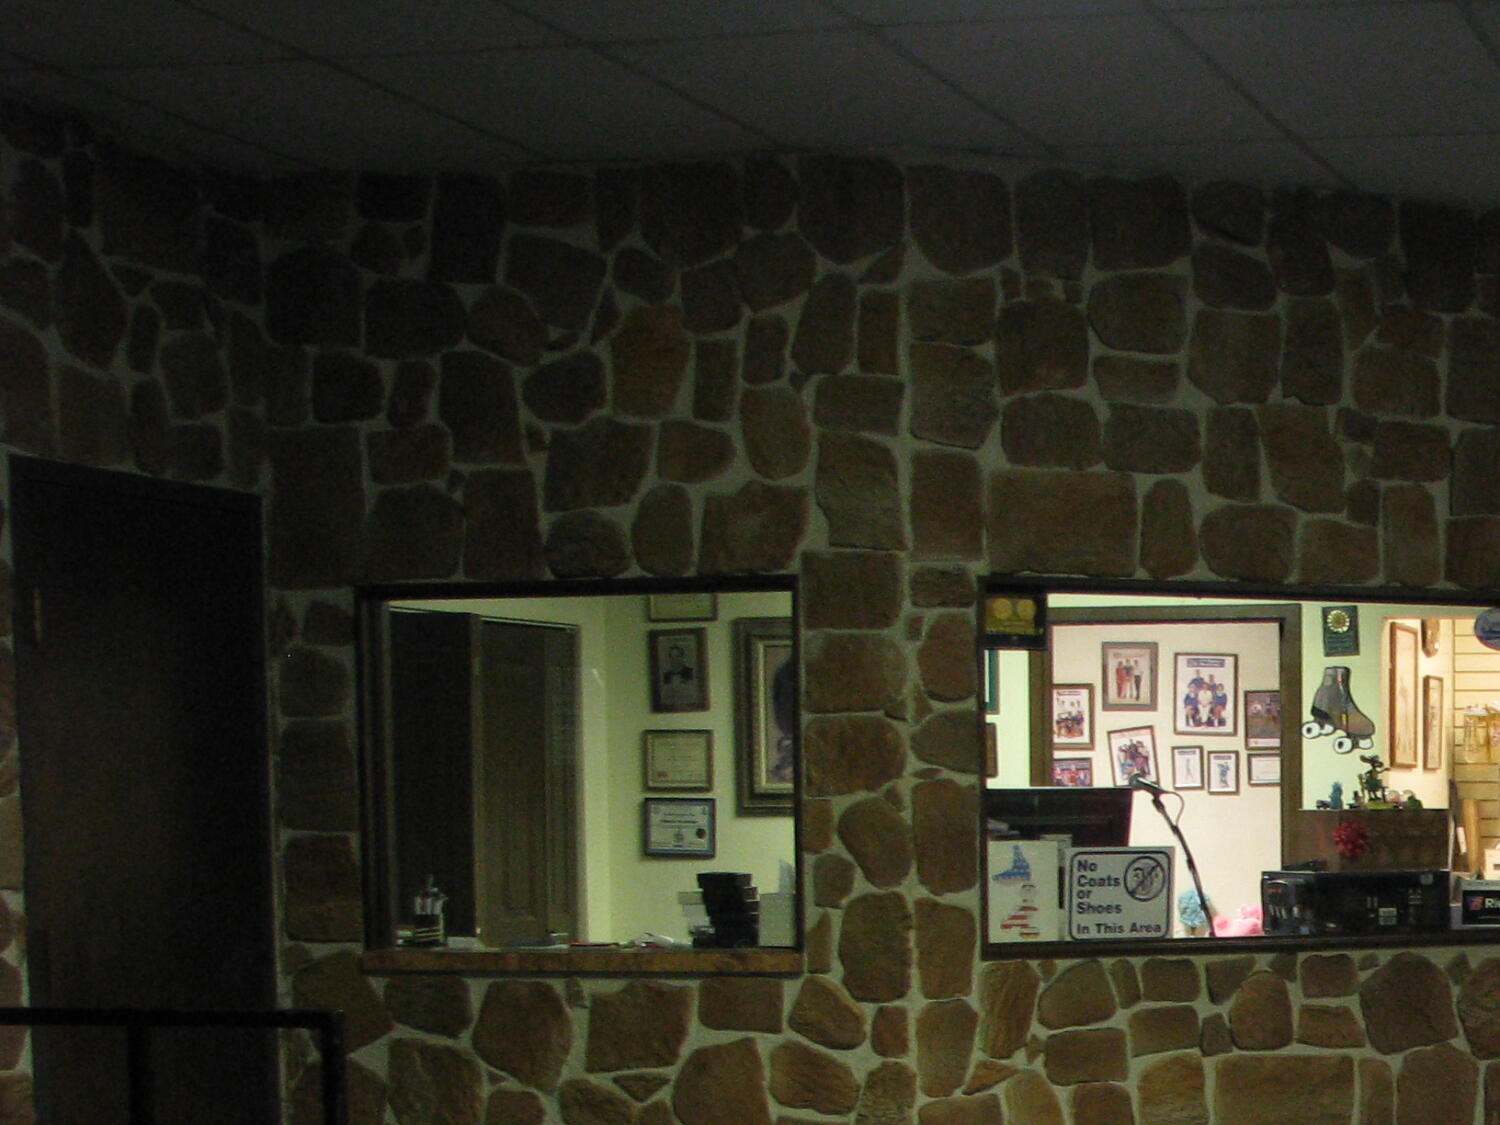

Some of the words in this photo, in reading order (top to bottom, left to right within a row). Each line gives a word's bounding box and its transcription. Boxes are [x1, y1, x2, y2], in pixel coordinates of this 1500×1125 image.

[1077, 860, 1098, 872] No
[1077, 874, 1120, 887] Coats
[1077, 889, 1093, 900] or
[1077, 901, 1122, 914] Shoes
[1077, 923, 1090, 935] In
[1096, 923, 1125, 934] This
[1130, 921, 1162, 933] Area
